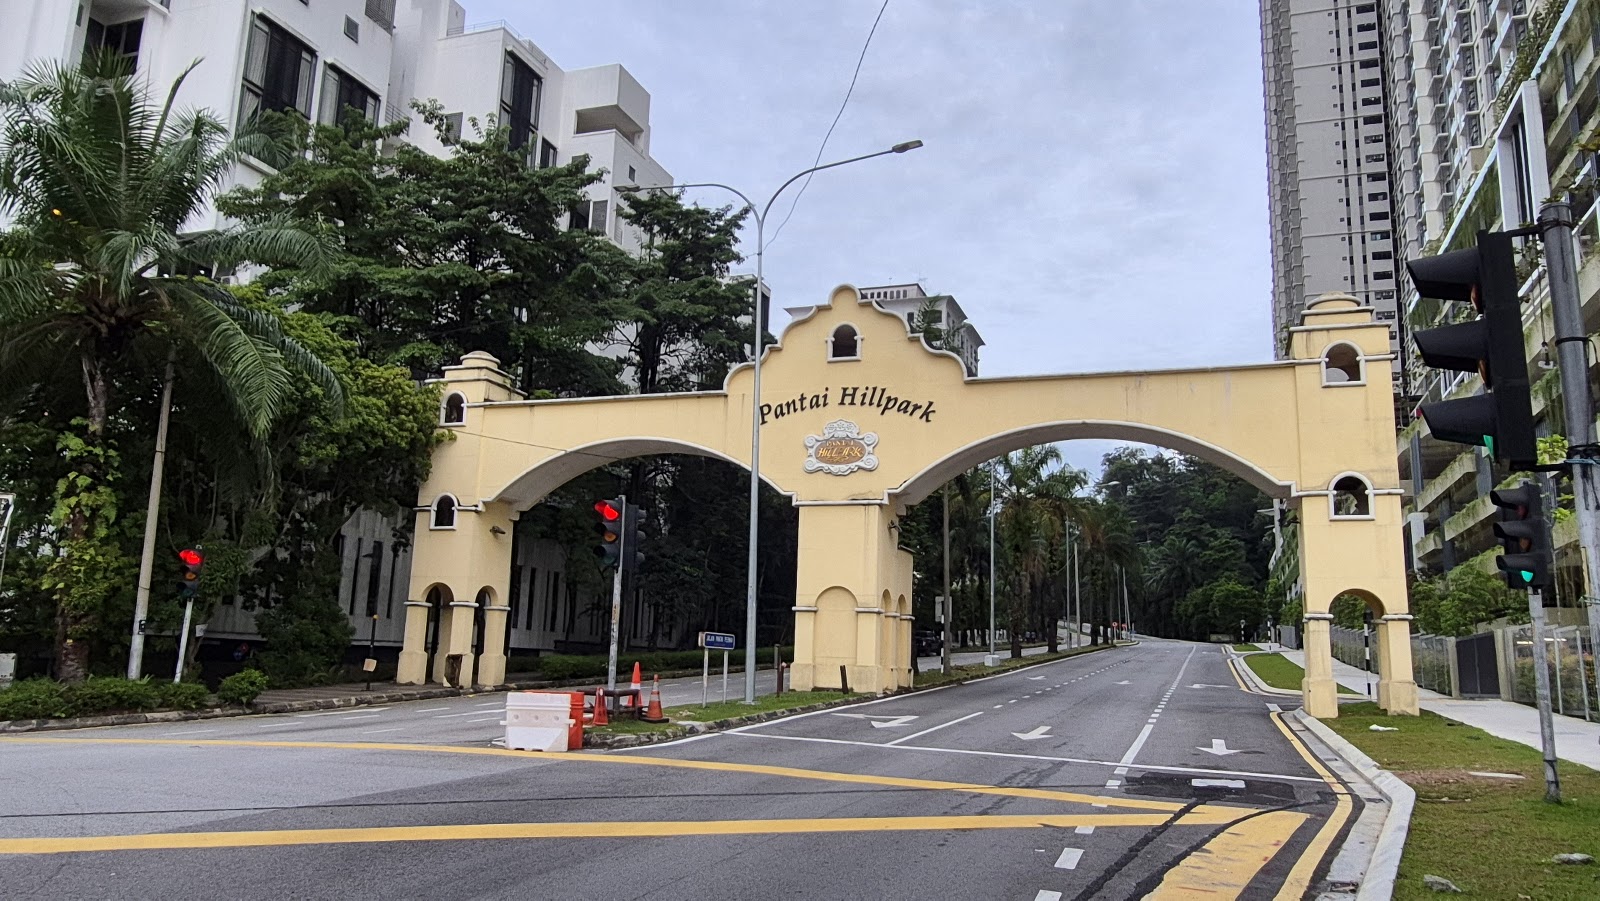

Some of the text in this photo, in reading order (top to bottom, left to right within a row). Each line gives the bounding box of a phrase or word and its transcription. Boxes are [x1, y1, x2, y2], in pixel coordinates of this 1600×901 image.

[759, 386, 936, 425] Pantai Hillpark
[818, 447, 863, 457] HILLARK
